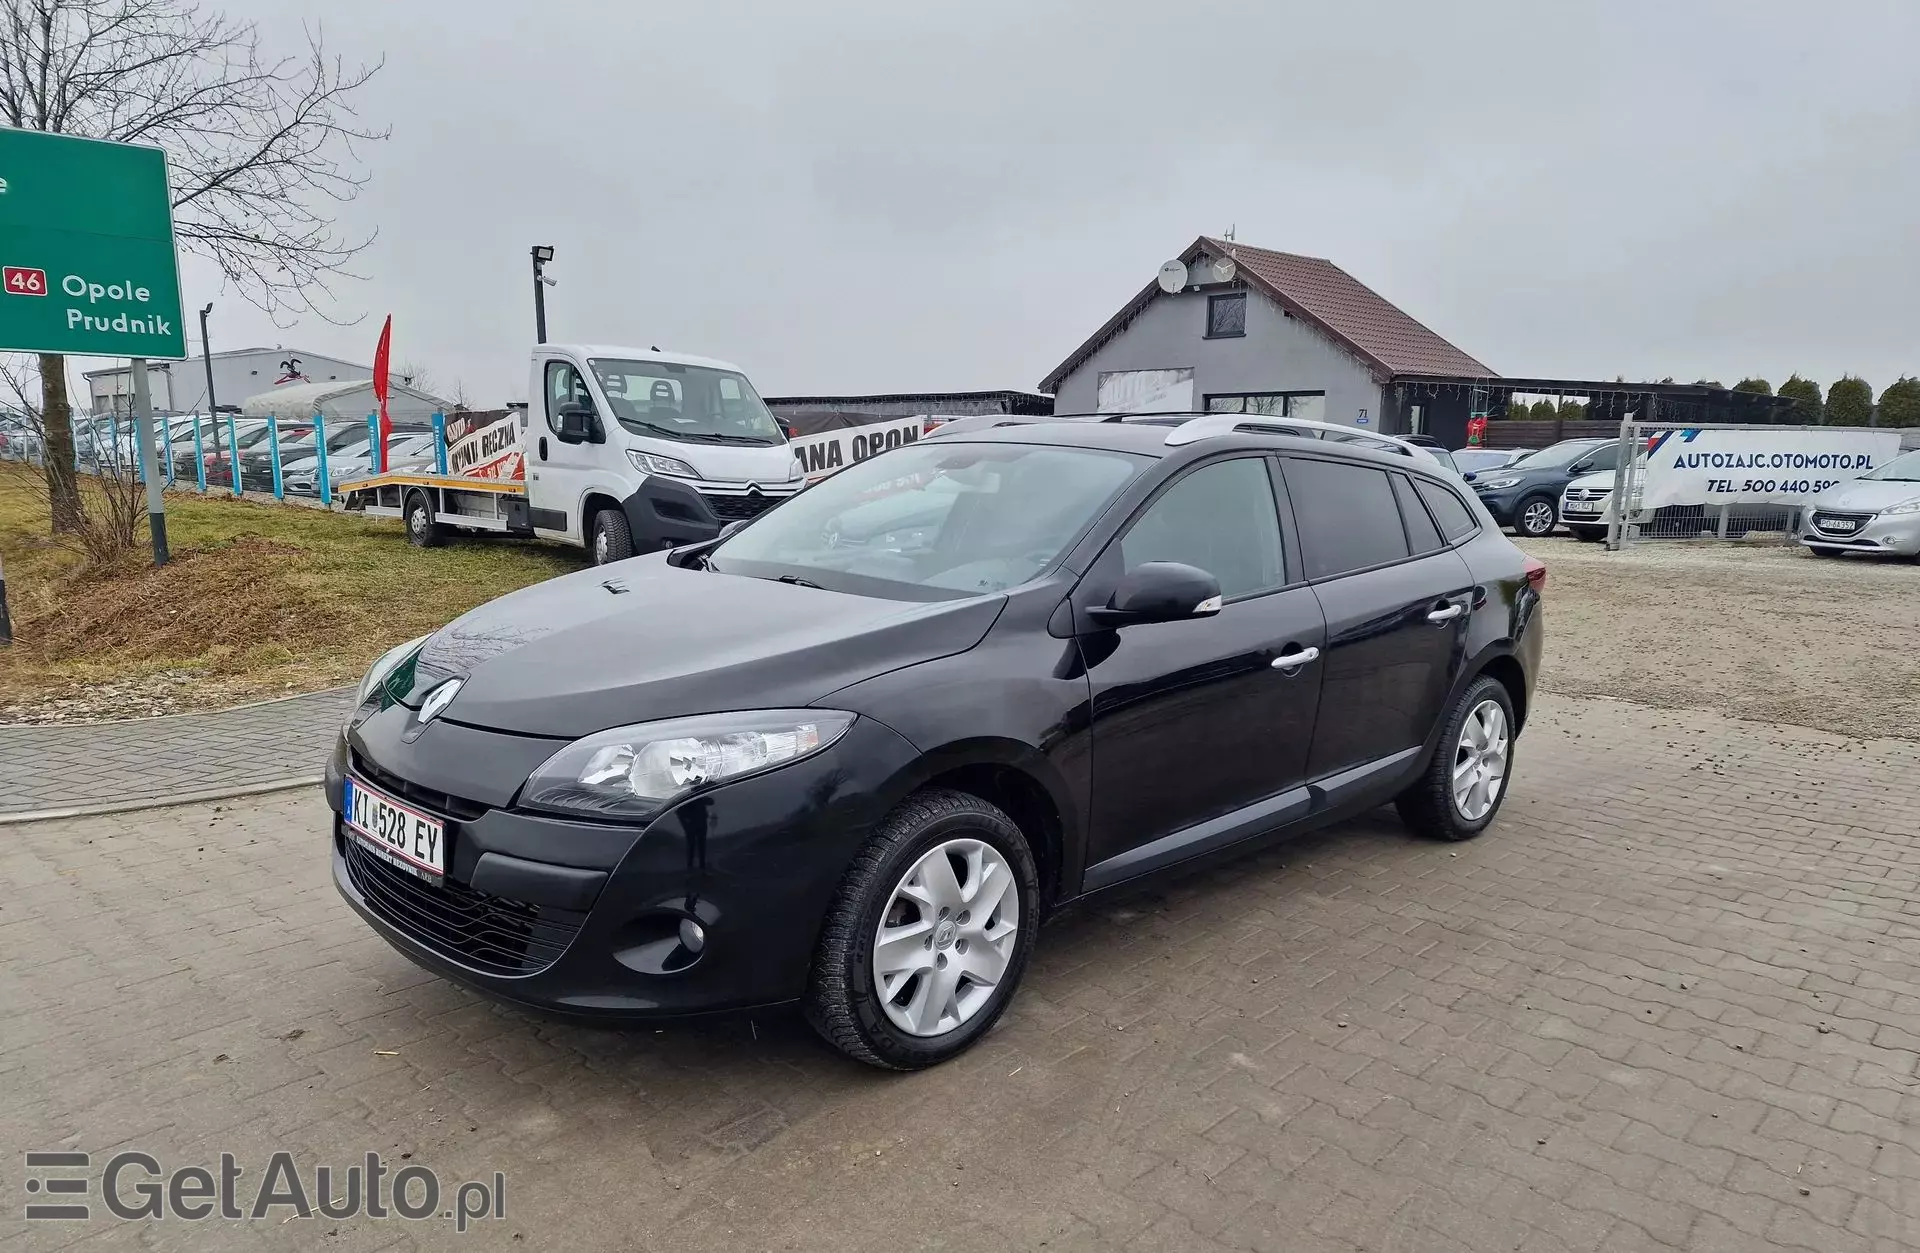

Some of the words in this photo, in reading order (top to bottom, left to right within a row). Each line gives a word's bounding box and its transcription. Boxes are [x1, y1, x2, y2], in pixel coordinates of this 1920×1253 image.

[11, 272, 40, 291] 46
[62, 275, 150, 303] Opole
[66, 308, 172, 336] Prudnik
[1358, 408, 1368, 418] 71
[852, 425, 918, 463] OPON
[1673, 453, 1874, 470] AUTOZAJC.OTOMOTO.PL
[1707, 480, 1737, 493] TEL.
[1741, 480, 1776, 493] 500
[1780, 480, 1810, 493] 440
[353, 788, 369, 829] KI
[379, 802, 406, 849] 528
[414, 819, 438, 864] EY
